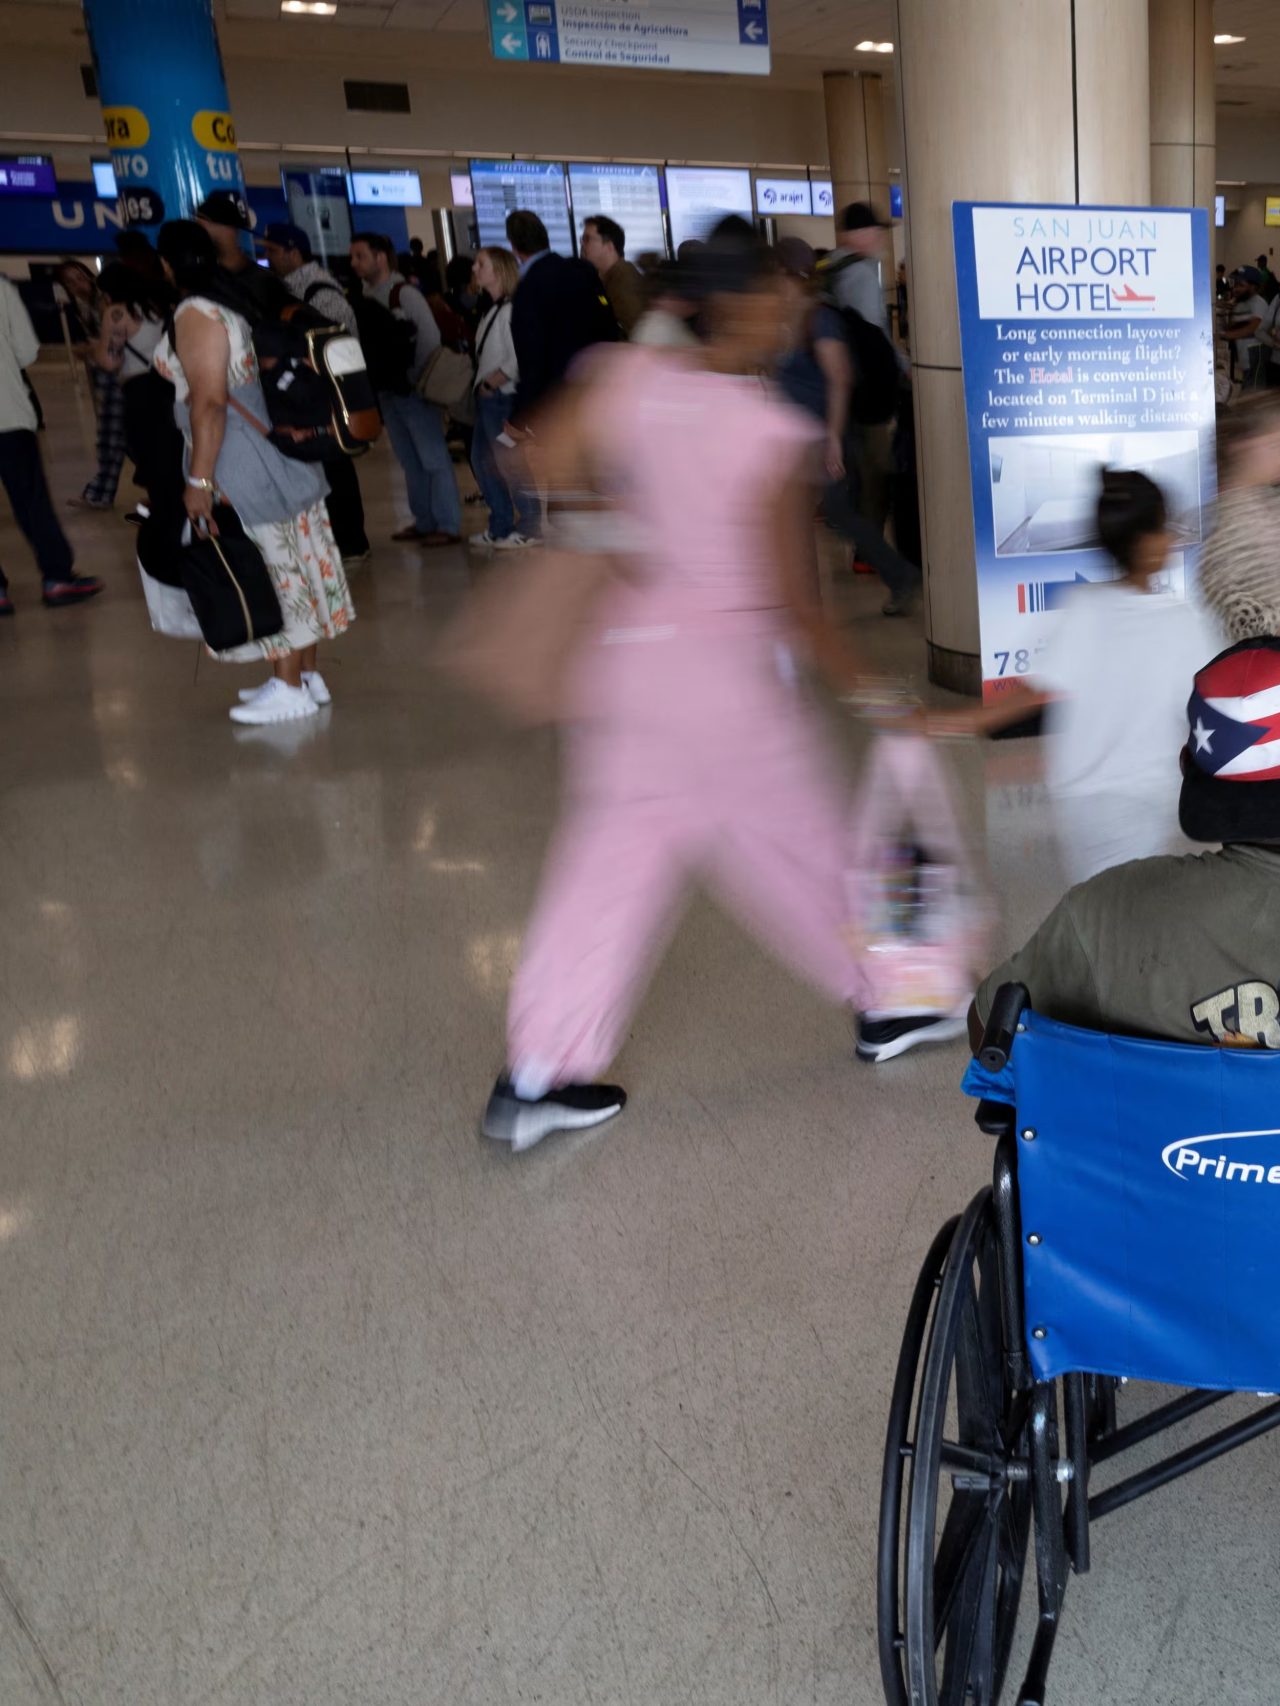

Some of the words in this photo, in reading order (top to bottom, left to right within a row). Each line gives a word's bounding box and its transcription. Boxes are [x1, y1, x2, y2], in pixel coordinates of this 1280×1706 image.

[590, 7, 641, 21] Inspection
[562, 19, 616, 34] Inspección
[619, 23, 632, 33] de
[633, 23, 689, 37] Agricultura
[564, 37, 601, 50] Security
[604, 39, 658, 52] Checkpoint
[565, 49, 603, 60] Control
[605, 51, 617, 61] de
[620, 52, 670, 65] Seguridad
[780, 191, 803, 206] arajet
[1013, 217, 1070, 239] SAN
[1088, 219, 1158, 243] JUAN
[1016, 246, 1158, 276] AIRPORT
[1016, 283, 1122, 312] HOTEL
[996, 324, 1037, 345] Long
[1040, 324, 1122, 341] connection
[1127, 323, 1181, 343] layover
[1002, 350, 1019, 362] or
[1024, 346, 1062, 366] early
[1068, 346, 1131, 365] morning
[1135, 344, 1181, 364] flight?
[994, 368, 1025, 384] The
[1029, 367, 1073, 384] Hotel
[1077, 367, 1090, 383] is
[1093, 366, 1187, 384] conveniently
[988, 389, 1043, 408] located
[1048, 394, 1067, 405] on
[1071, 387, 1137, 405] Terminal
[1143, 387, 1156, 402] D
[1160, 387, 1184, 406] just
[982, 413, 1009, 430] few
[1014, 411, 1074, 428] minutes
[1078, 409, 1137, 428] walking
